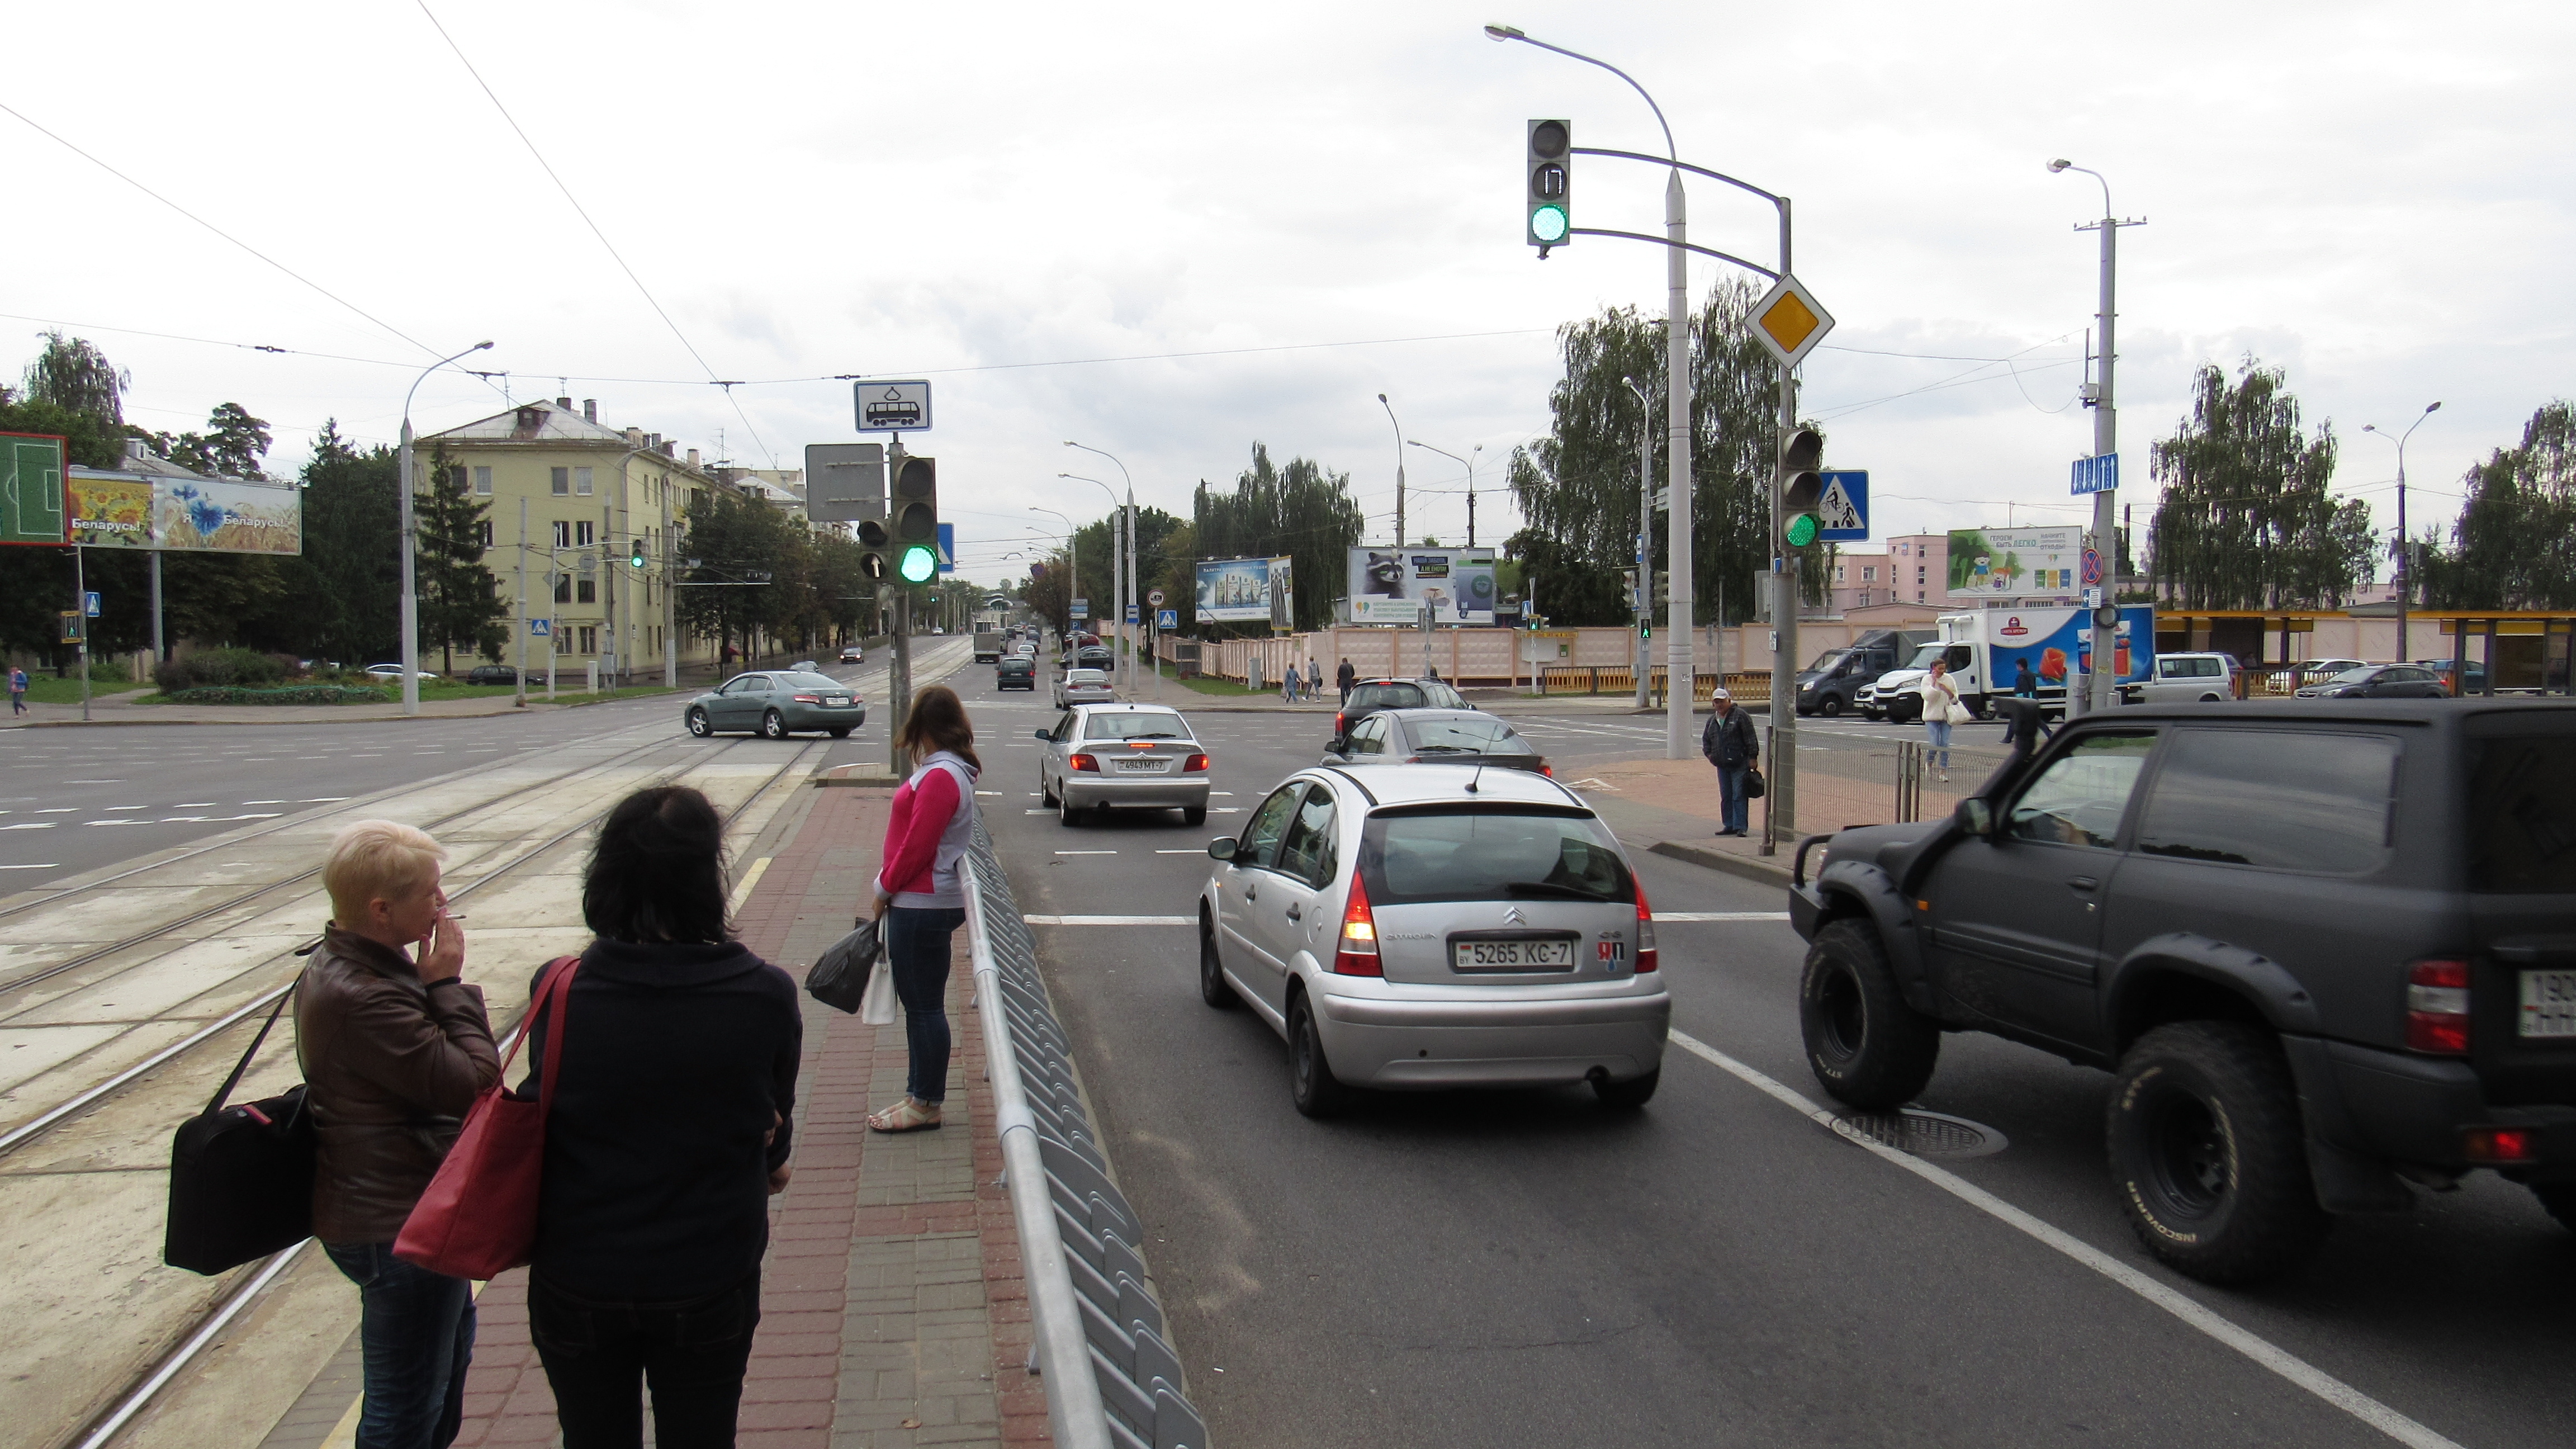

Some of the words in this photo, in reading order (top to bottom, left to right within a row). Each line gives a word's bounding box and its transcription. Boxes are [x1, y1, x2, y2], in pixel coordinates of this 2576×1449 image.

[72, 518, 141, 533] Беларусь!
[183, 513, 192, 523] Я
[224, 514, 283, 529] Беларусь!
[1125, 761, 1143, 769] 4943
[1144, 761, 1163, 769] MT-7
[1474, 944, 1519, 964] 5265
[1525, 941, 1568, 963] KC-7
